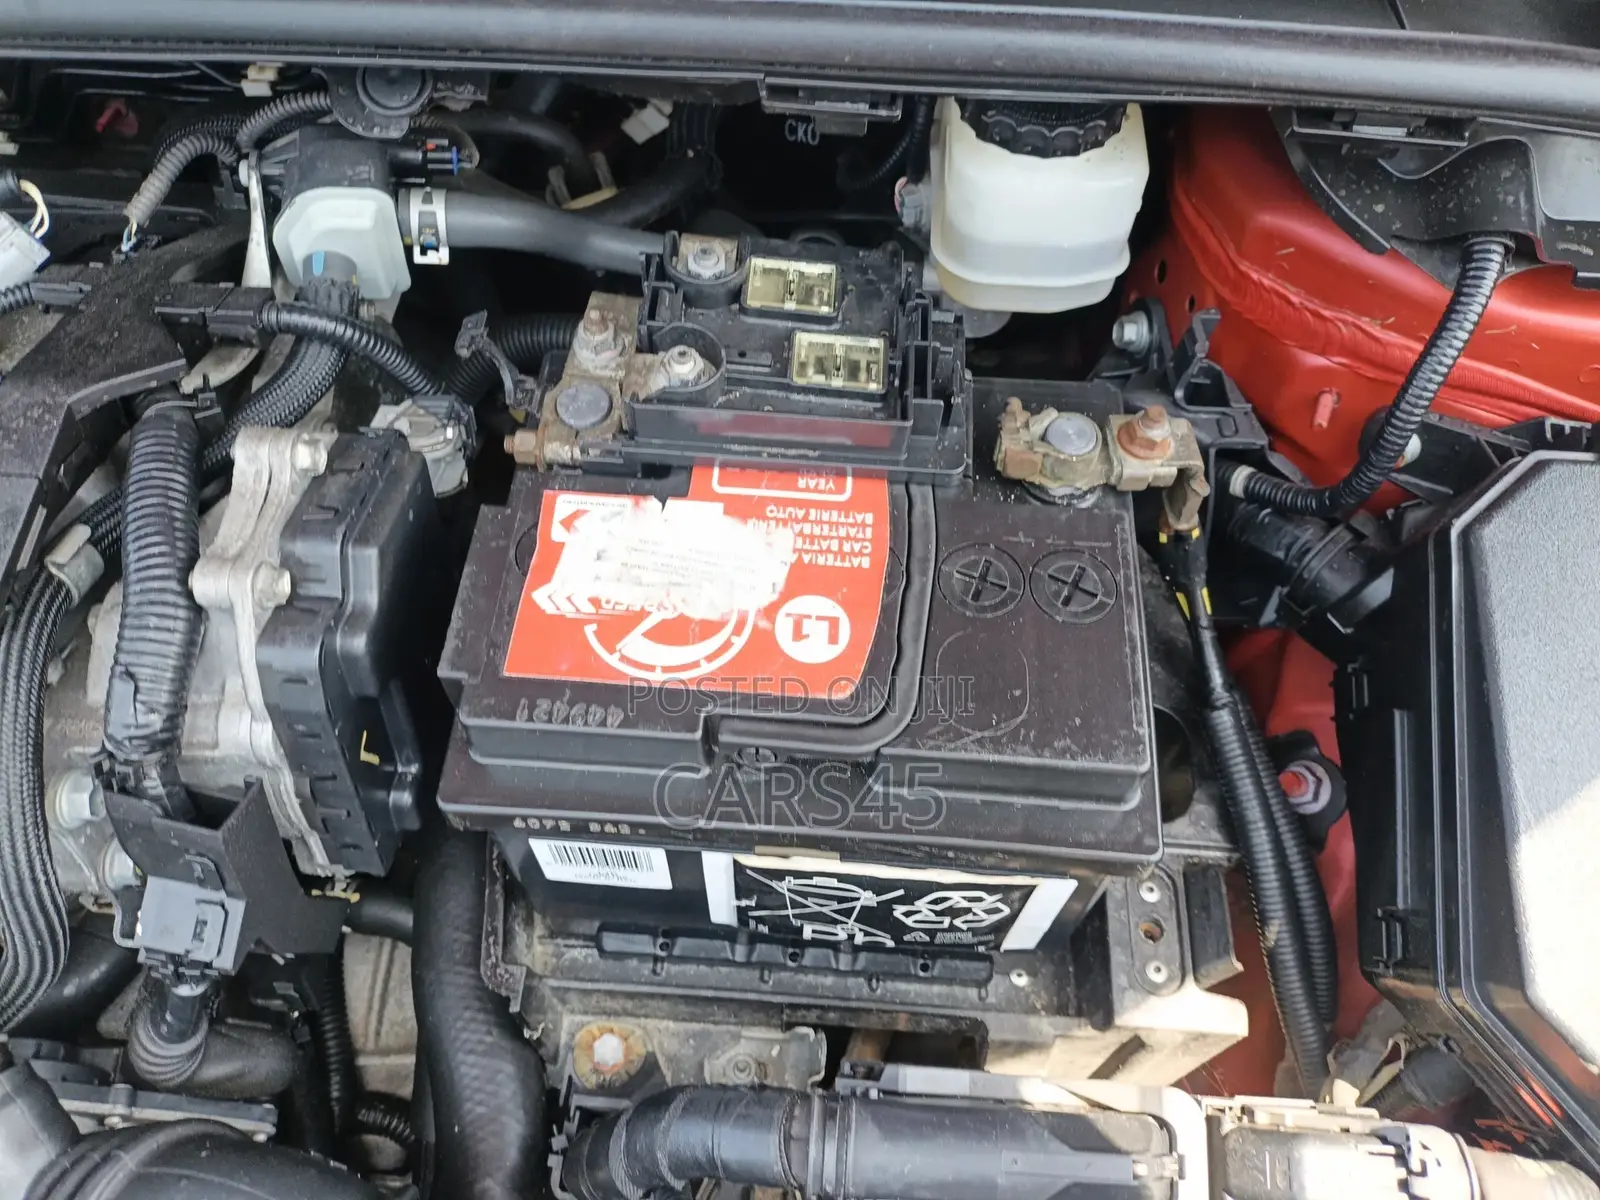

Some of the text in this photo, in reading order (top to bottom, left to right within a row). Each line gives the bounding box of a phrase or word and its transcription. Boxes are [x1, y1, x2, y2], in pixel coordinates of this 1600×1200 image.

[797, 476, 835, 491] YEAR
[766, 504, 873, 525] BATTERIE AUTO
[843, 540, 872, 554] CAR
[802, 552, 871, 569] BATTERIA
[785, 612, 841, 646] L1
